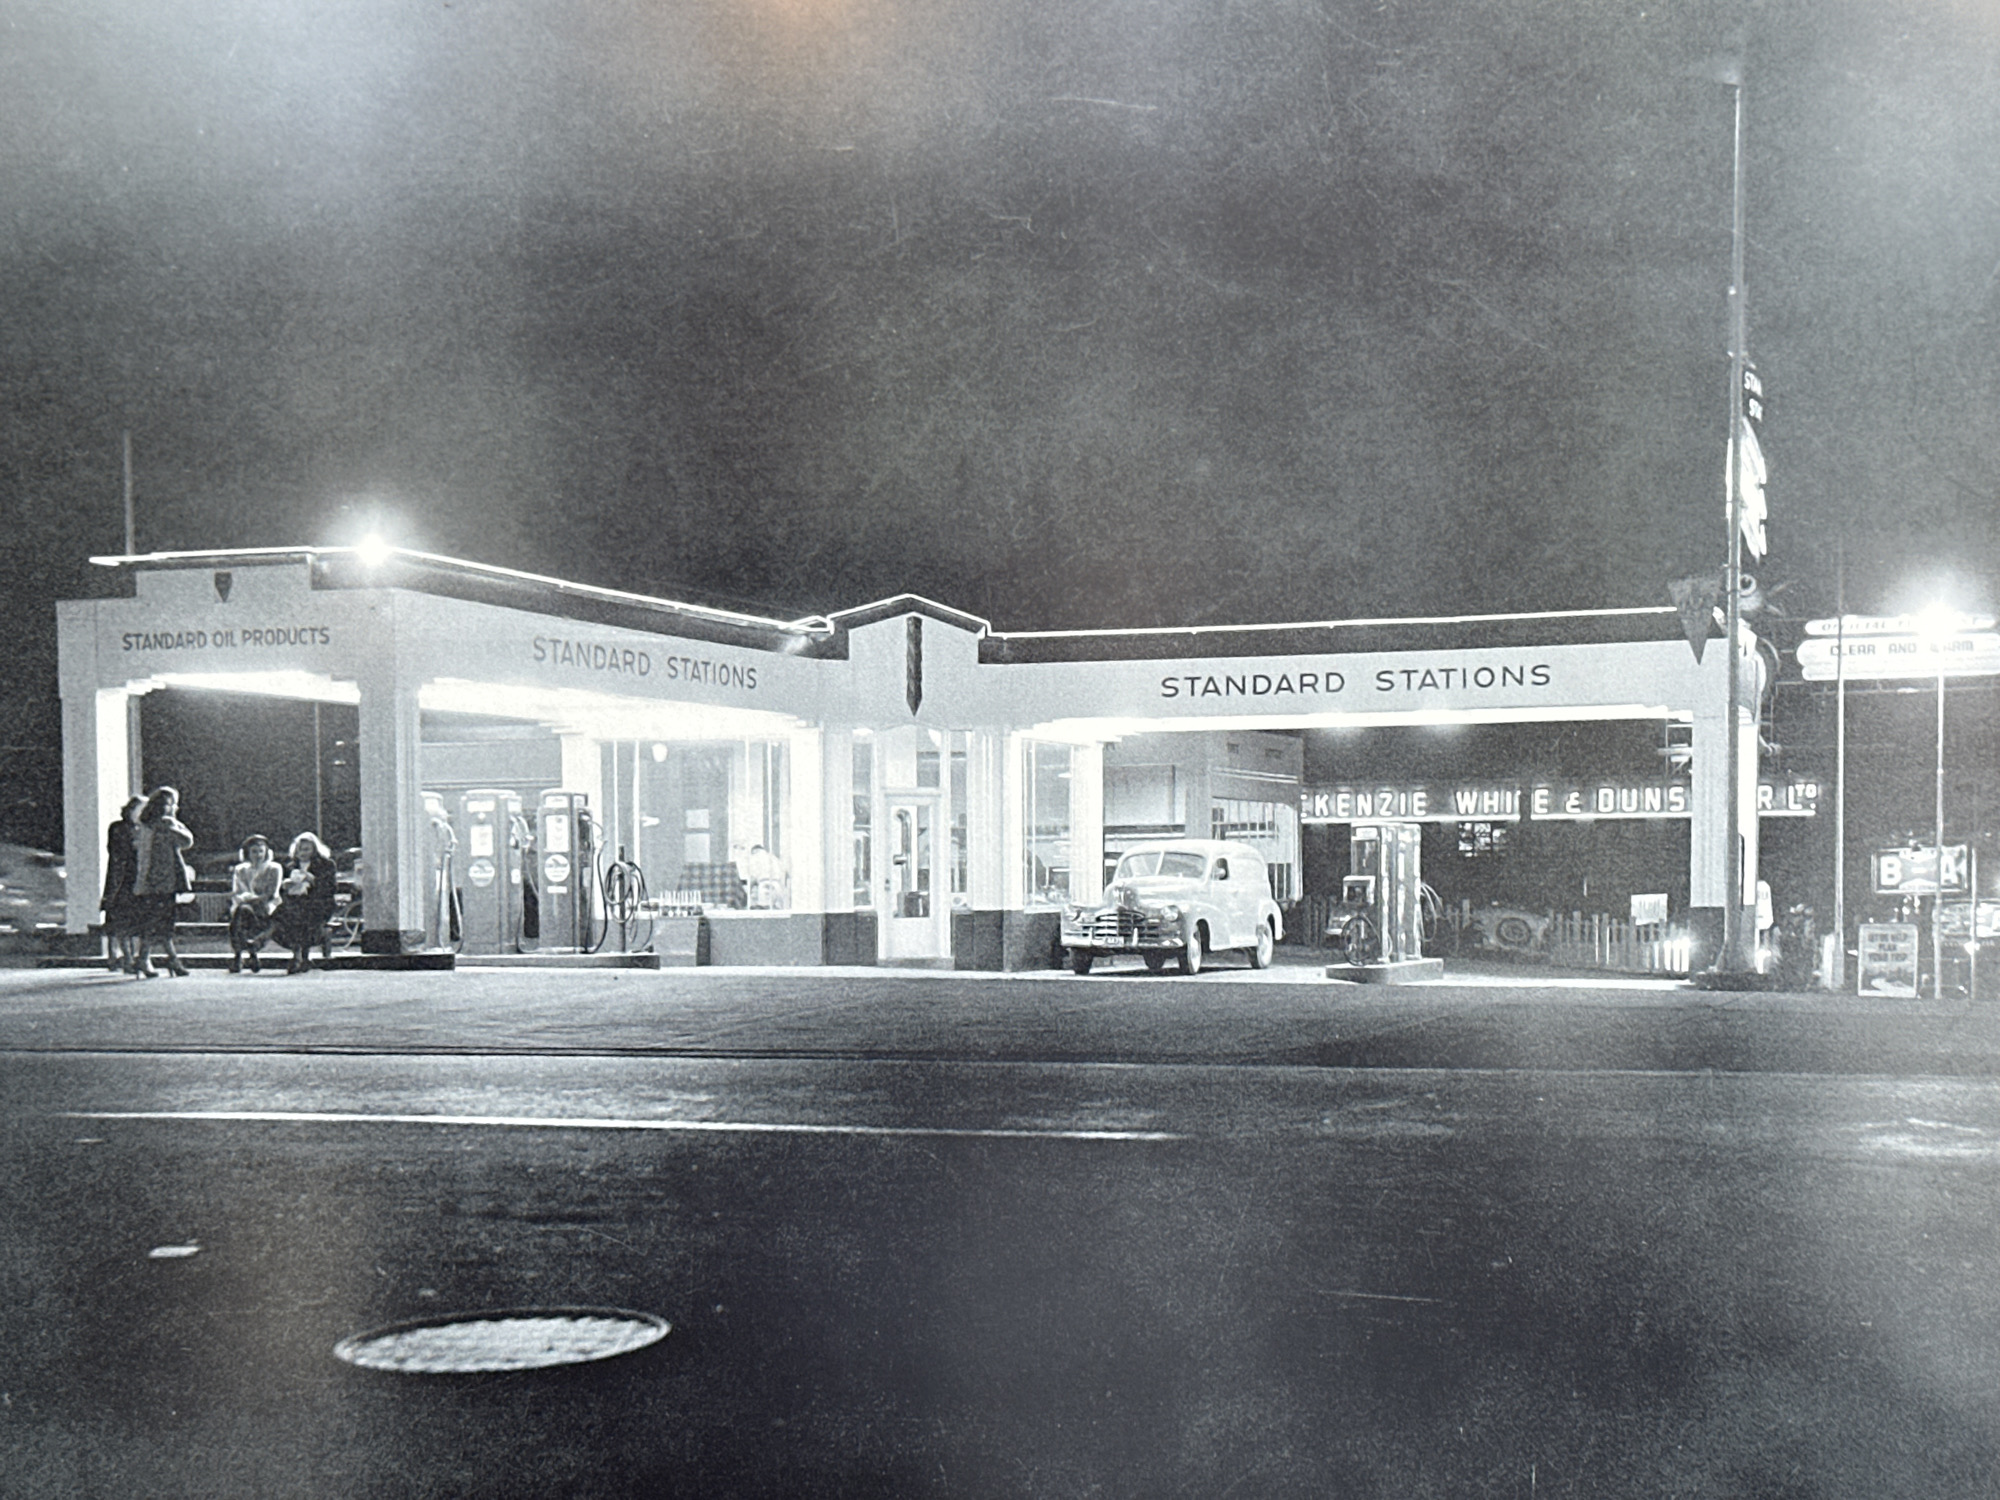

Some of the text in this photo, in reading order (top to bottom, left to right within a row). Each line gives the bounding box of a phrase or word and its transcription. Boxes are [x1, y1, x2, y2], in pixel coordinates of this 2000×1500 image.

[122, 626, 330, 651] STANDARD OIL PRODUCTS
[1888, 642, 1917, 655] AND
[533, 636, 757, 690] STANDARD STATIONS
[1161, 664, 1552, 698] STANDARD STATIONS
